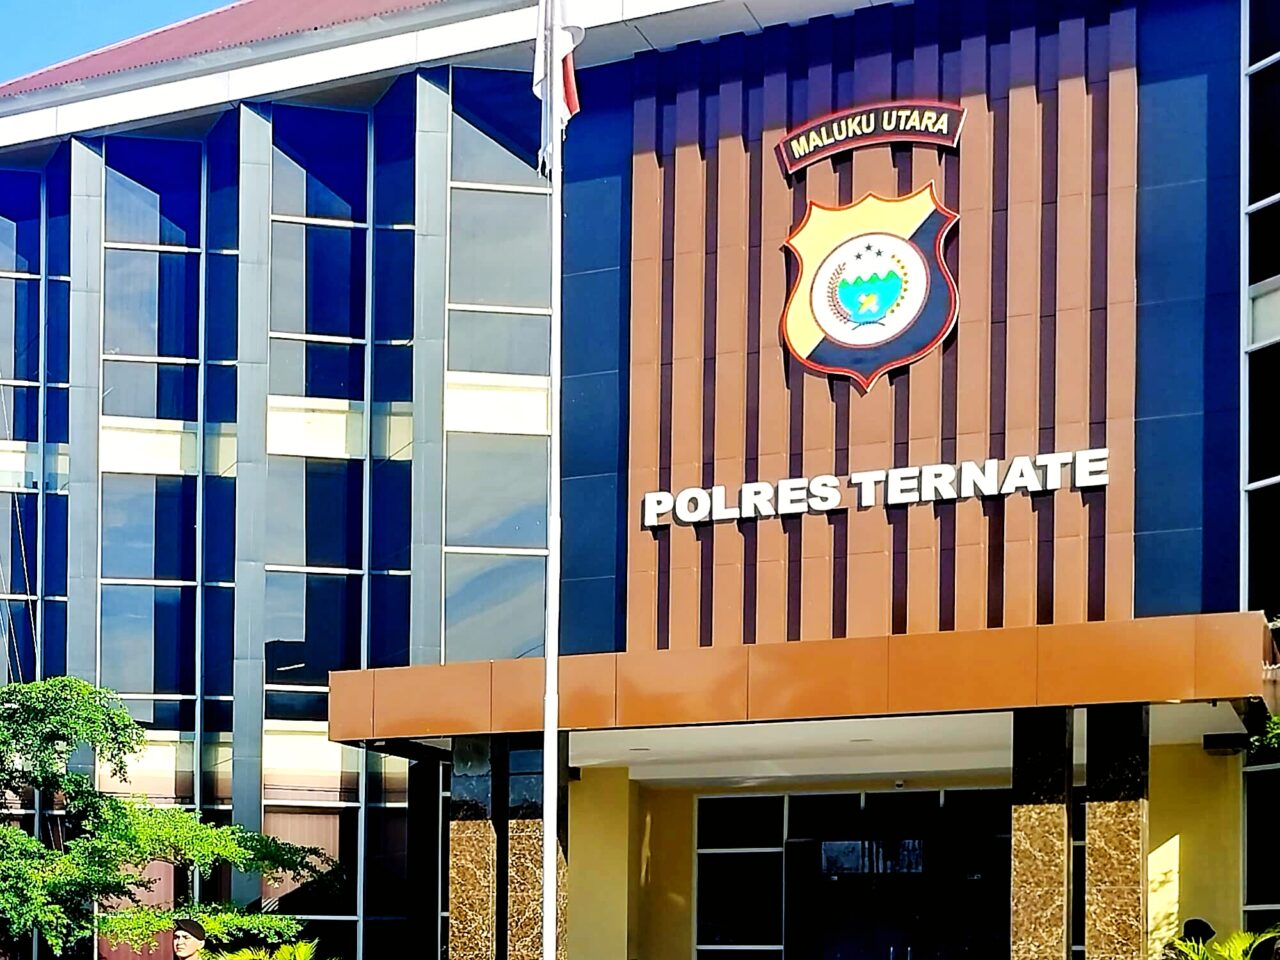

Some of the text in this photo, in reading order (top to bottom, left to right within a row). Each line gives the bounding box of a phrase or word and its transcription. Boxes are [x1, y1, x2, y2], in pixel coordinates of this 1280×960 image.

[790, 108, 949, 159] MALUKU UTARA
[642, 447, 1110, 527] POLRES TERNATE
